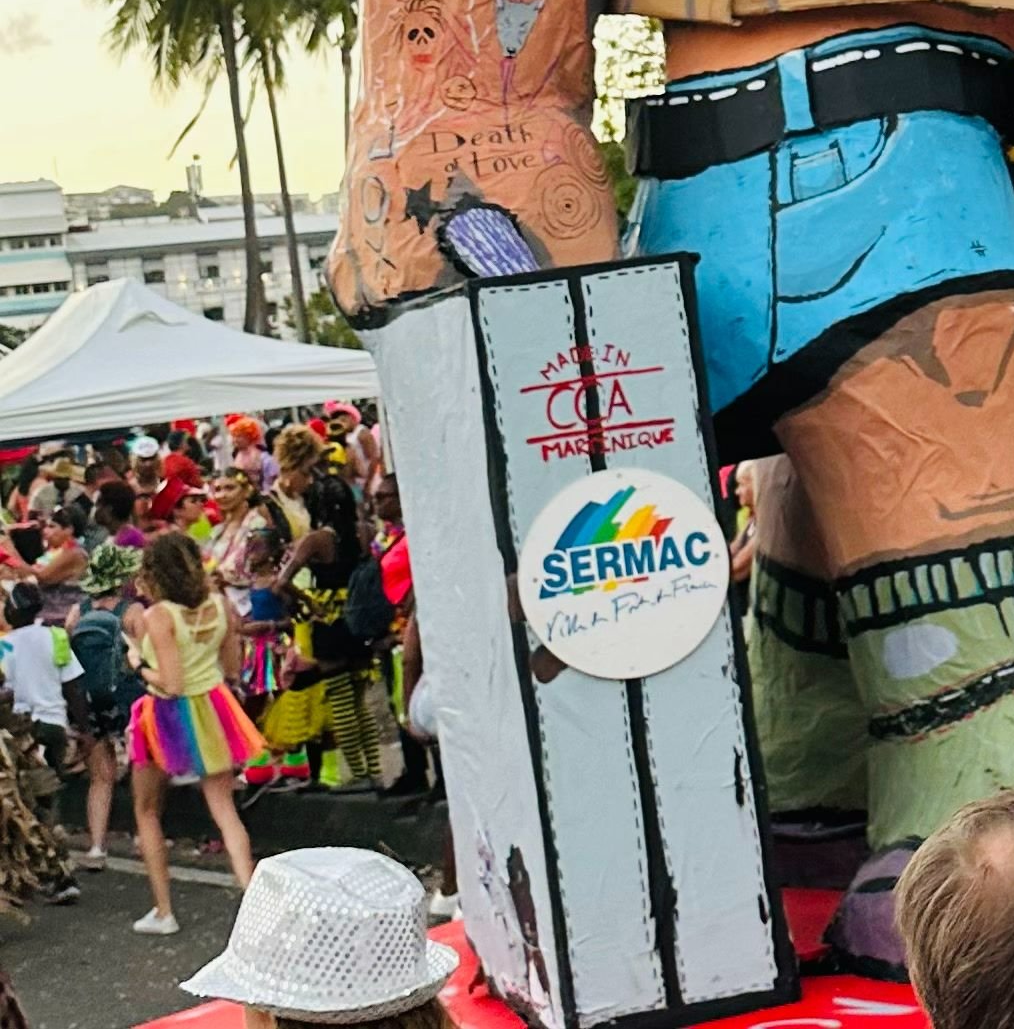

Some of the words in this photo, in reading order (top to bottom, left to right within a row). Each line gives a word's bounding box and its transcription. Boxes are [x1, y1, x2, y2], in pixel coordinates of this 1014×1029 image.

[431, 123, 534, 153] Death
[472, 151, 541, 180] Love
[540, 345, 594, 380] MADE
[601, 344, 630, 367] IN
[547, 379, 632, 429] CCA
[542, 428, 675, 462] MARTINIQUE
[542, 531, 711, 589] SERMAC
